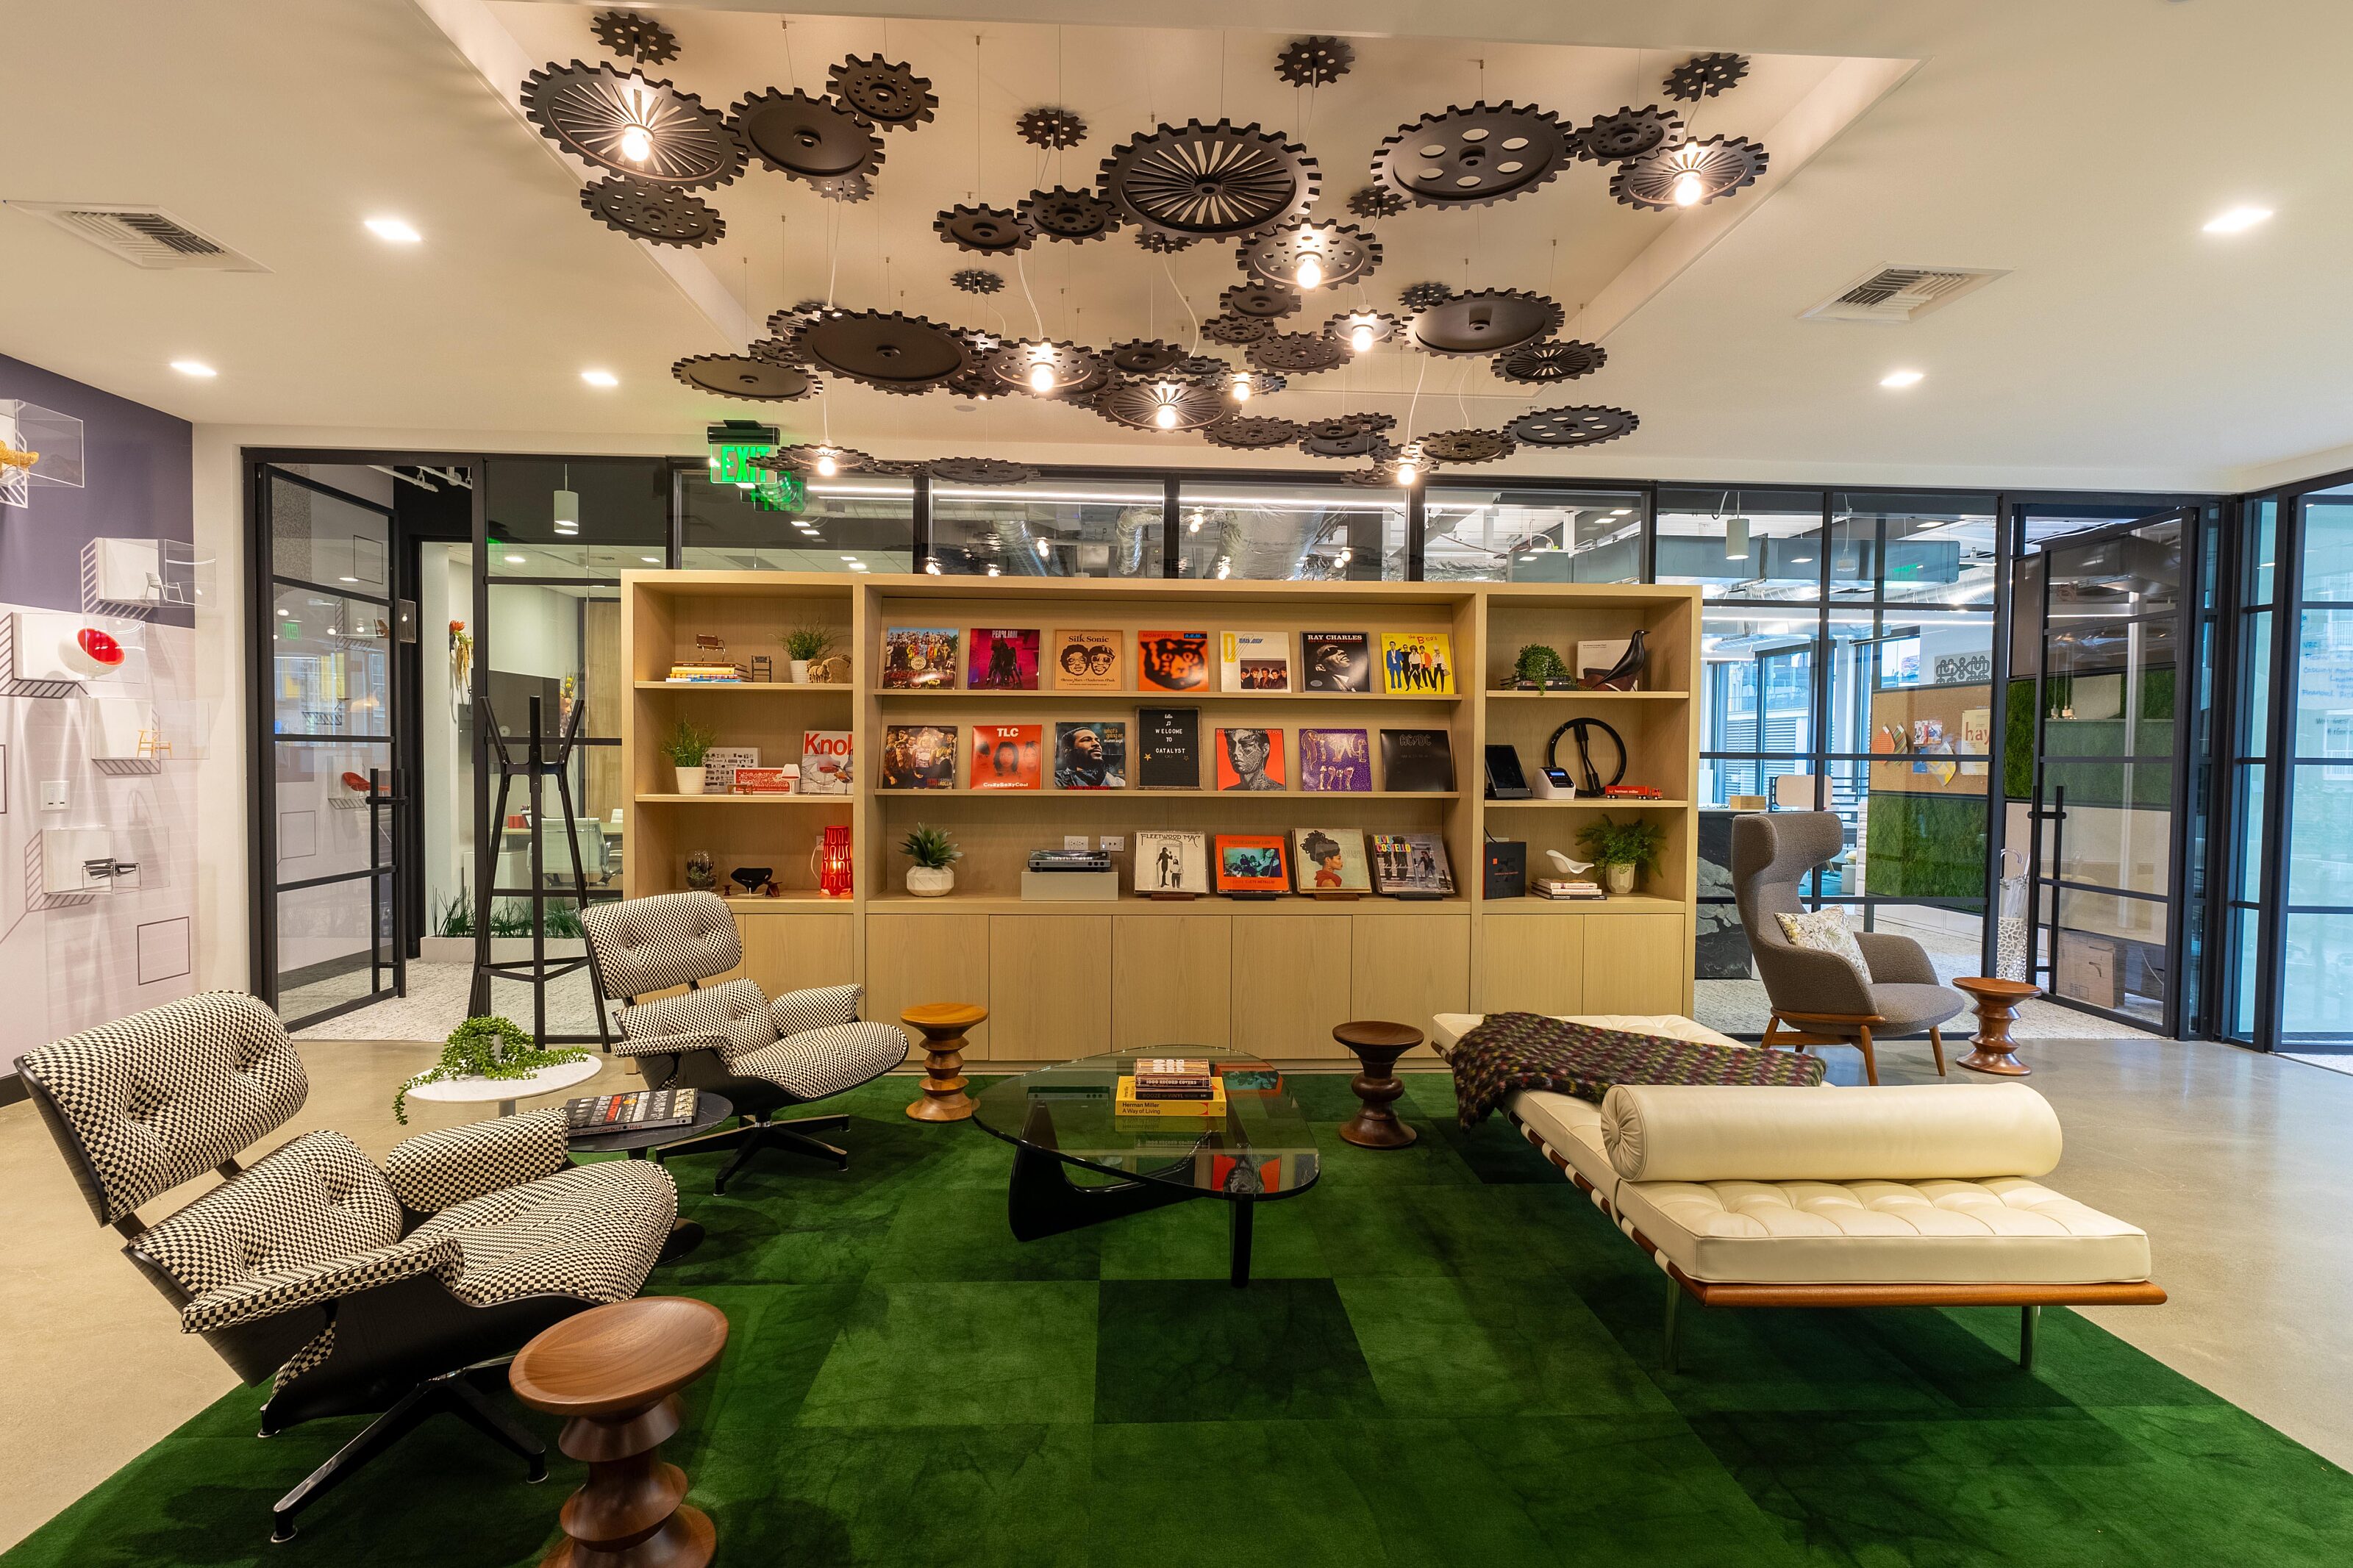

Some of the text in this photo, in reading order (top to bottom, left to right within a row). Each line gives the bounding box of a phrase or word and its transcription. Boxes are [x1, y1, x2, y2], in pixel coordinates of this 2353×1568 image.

[721, 445, 770, 482] EXIT
[992, 630, 1018, 638] PEARL JAM
[1068, 634, 1085, 642] Silk
[996, 728, 1019, 737] TLC
[804, 733, 853, 756] Knol
[1399, 734, 1432, 746] AC/DC
[1140, 834, 1201, 848] FLEETWOOD MAC
[1374, 835, 1412, 853] ELVIS COSTELLO
